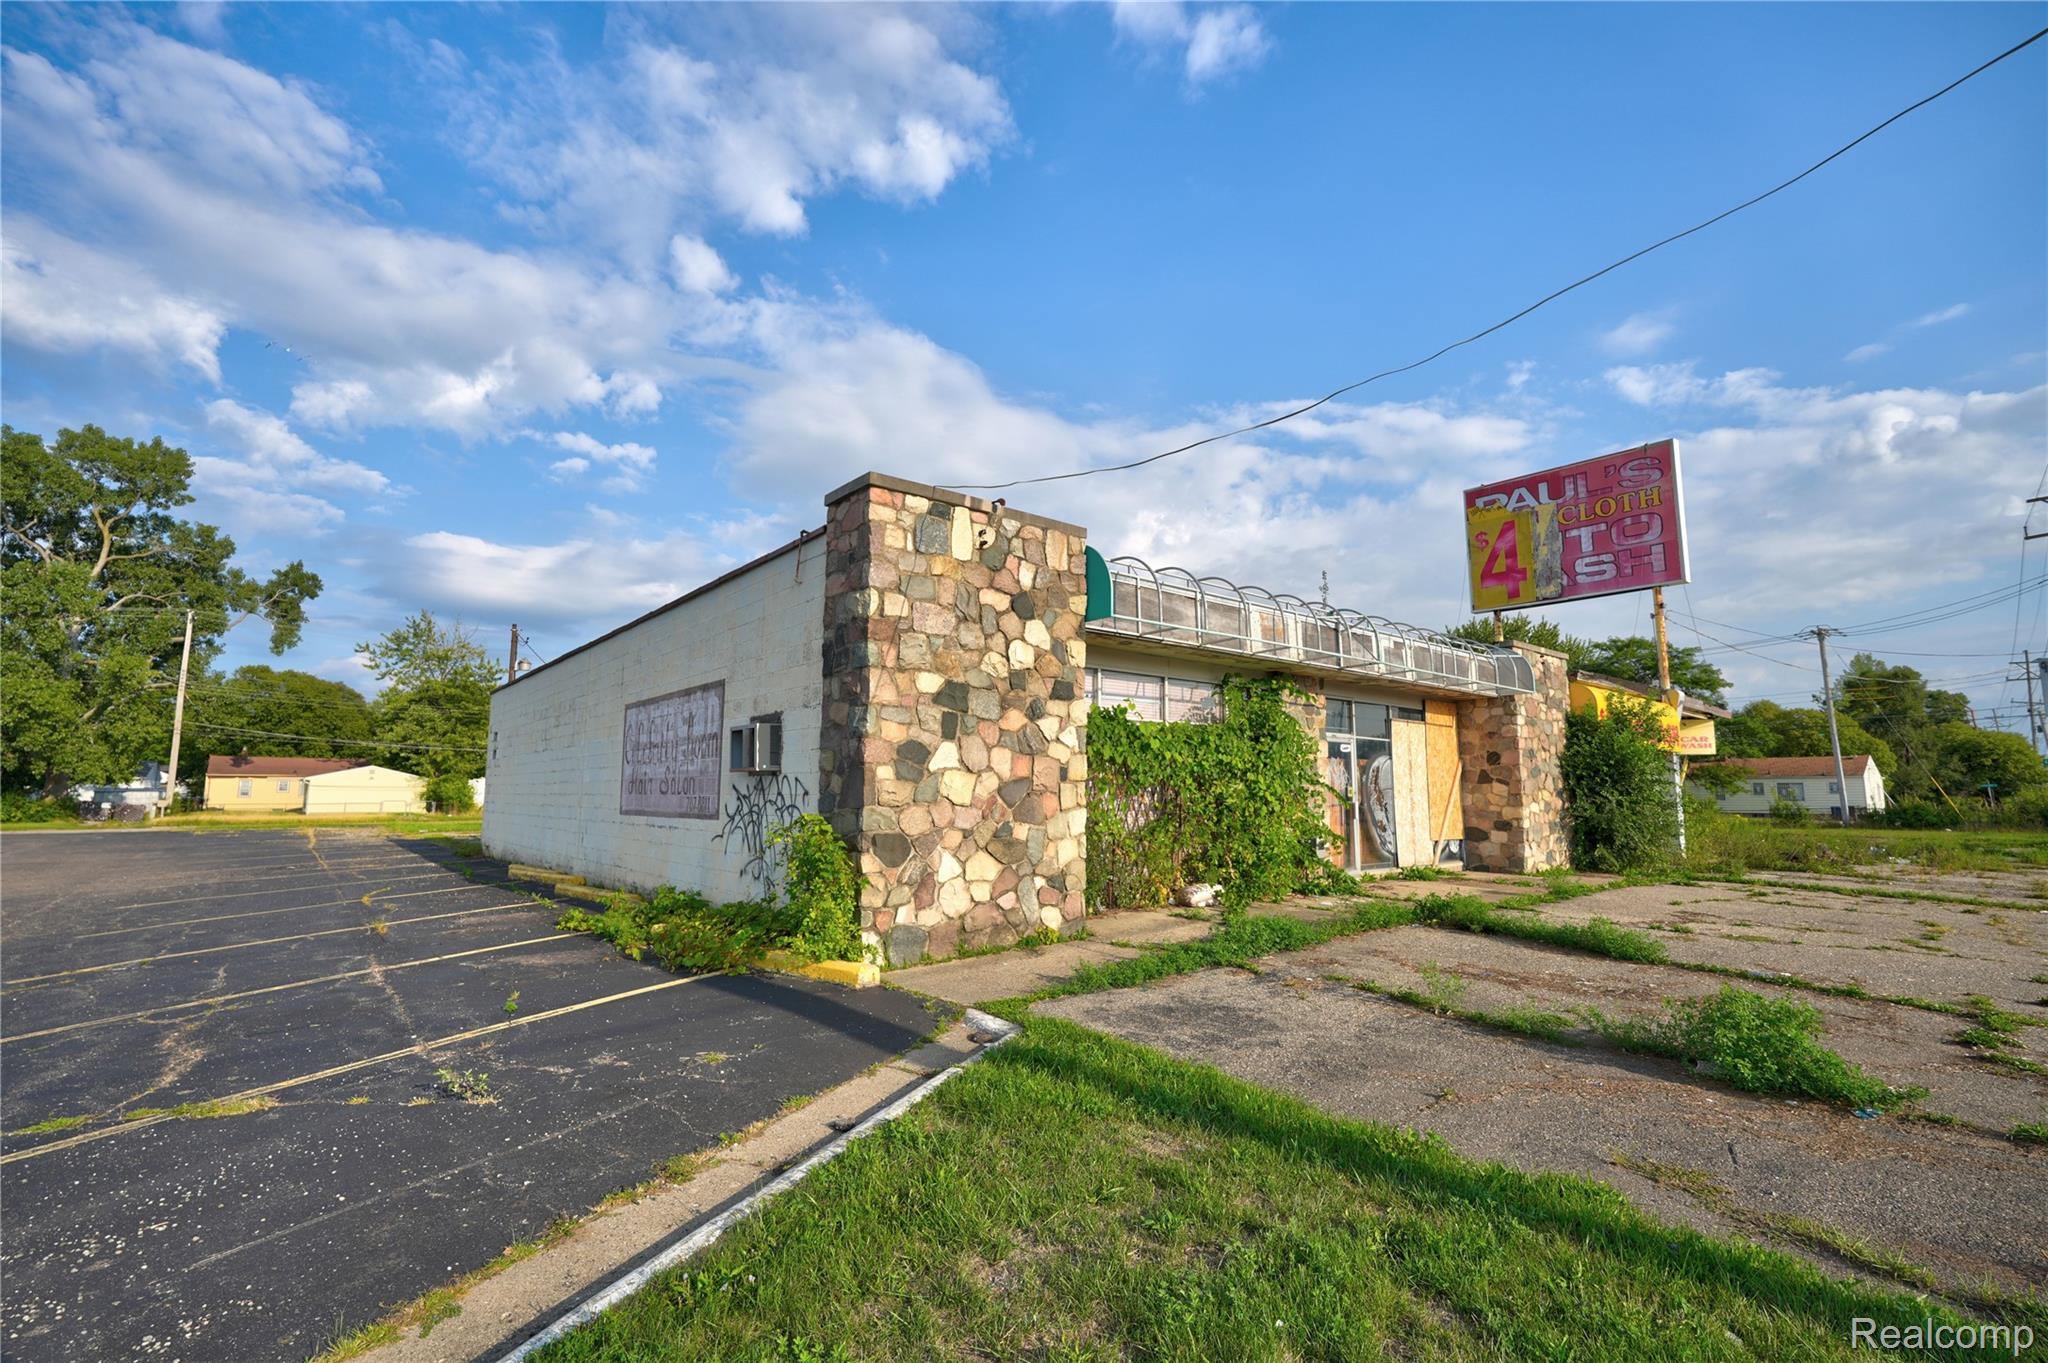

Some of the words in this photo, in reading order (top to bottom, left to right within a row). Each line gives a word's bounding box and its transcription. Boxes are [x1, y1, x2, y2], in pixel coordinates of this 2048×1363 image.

[1558, 485, 1662, 525] CLOTH
[1560, 512, 1664, 553] TO
[627, 767, 653, 795] Hair
[659, 765, 696, 796] Salon
